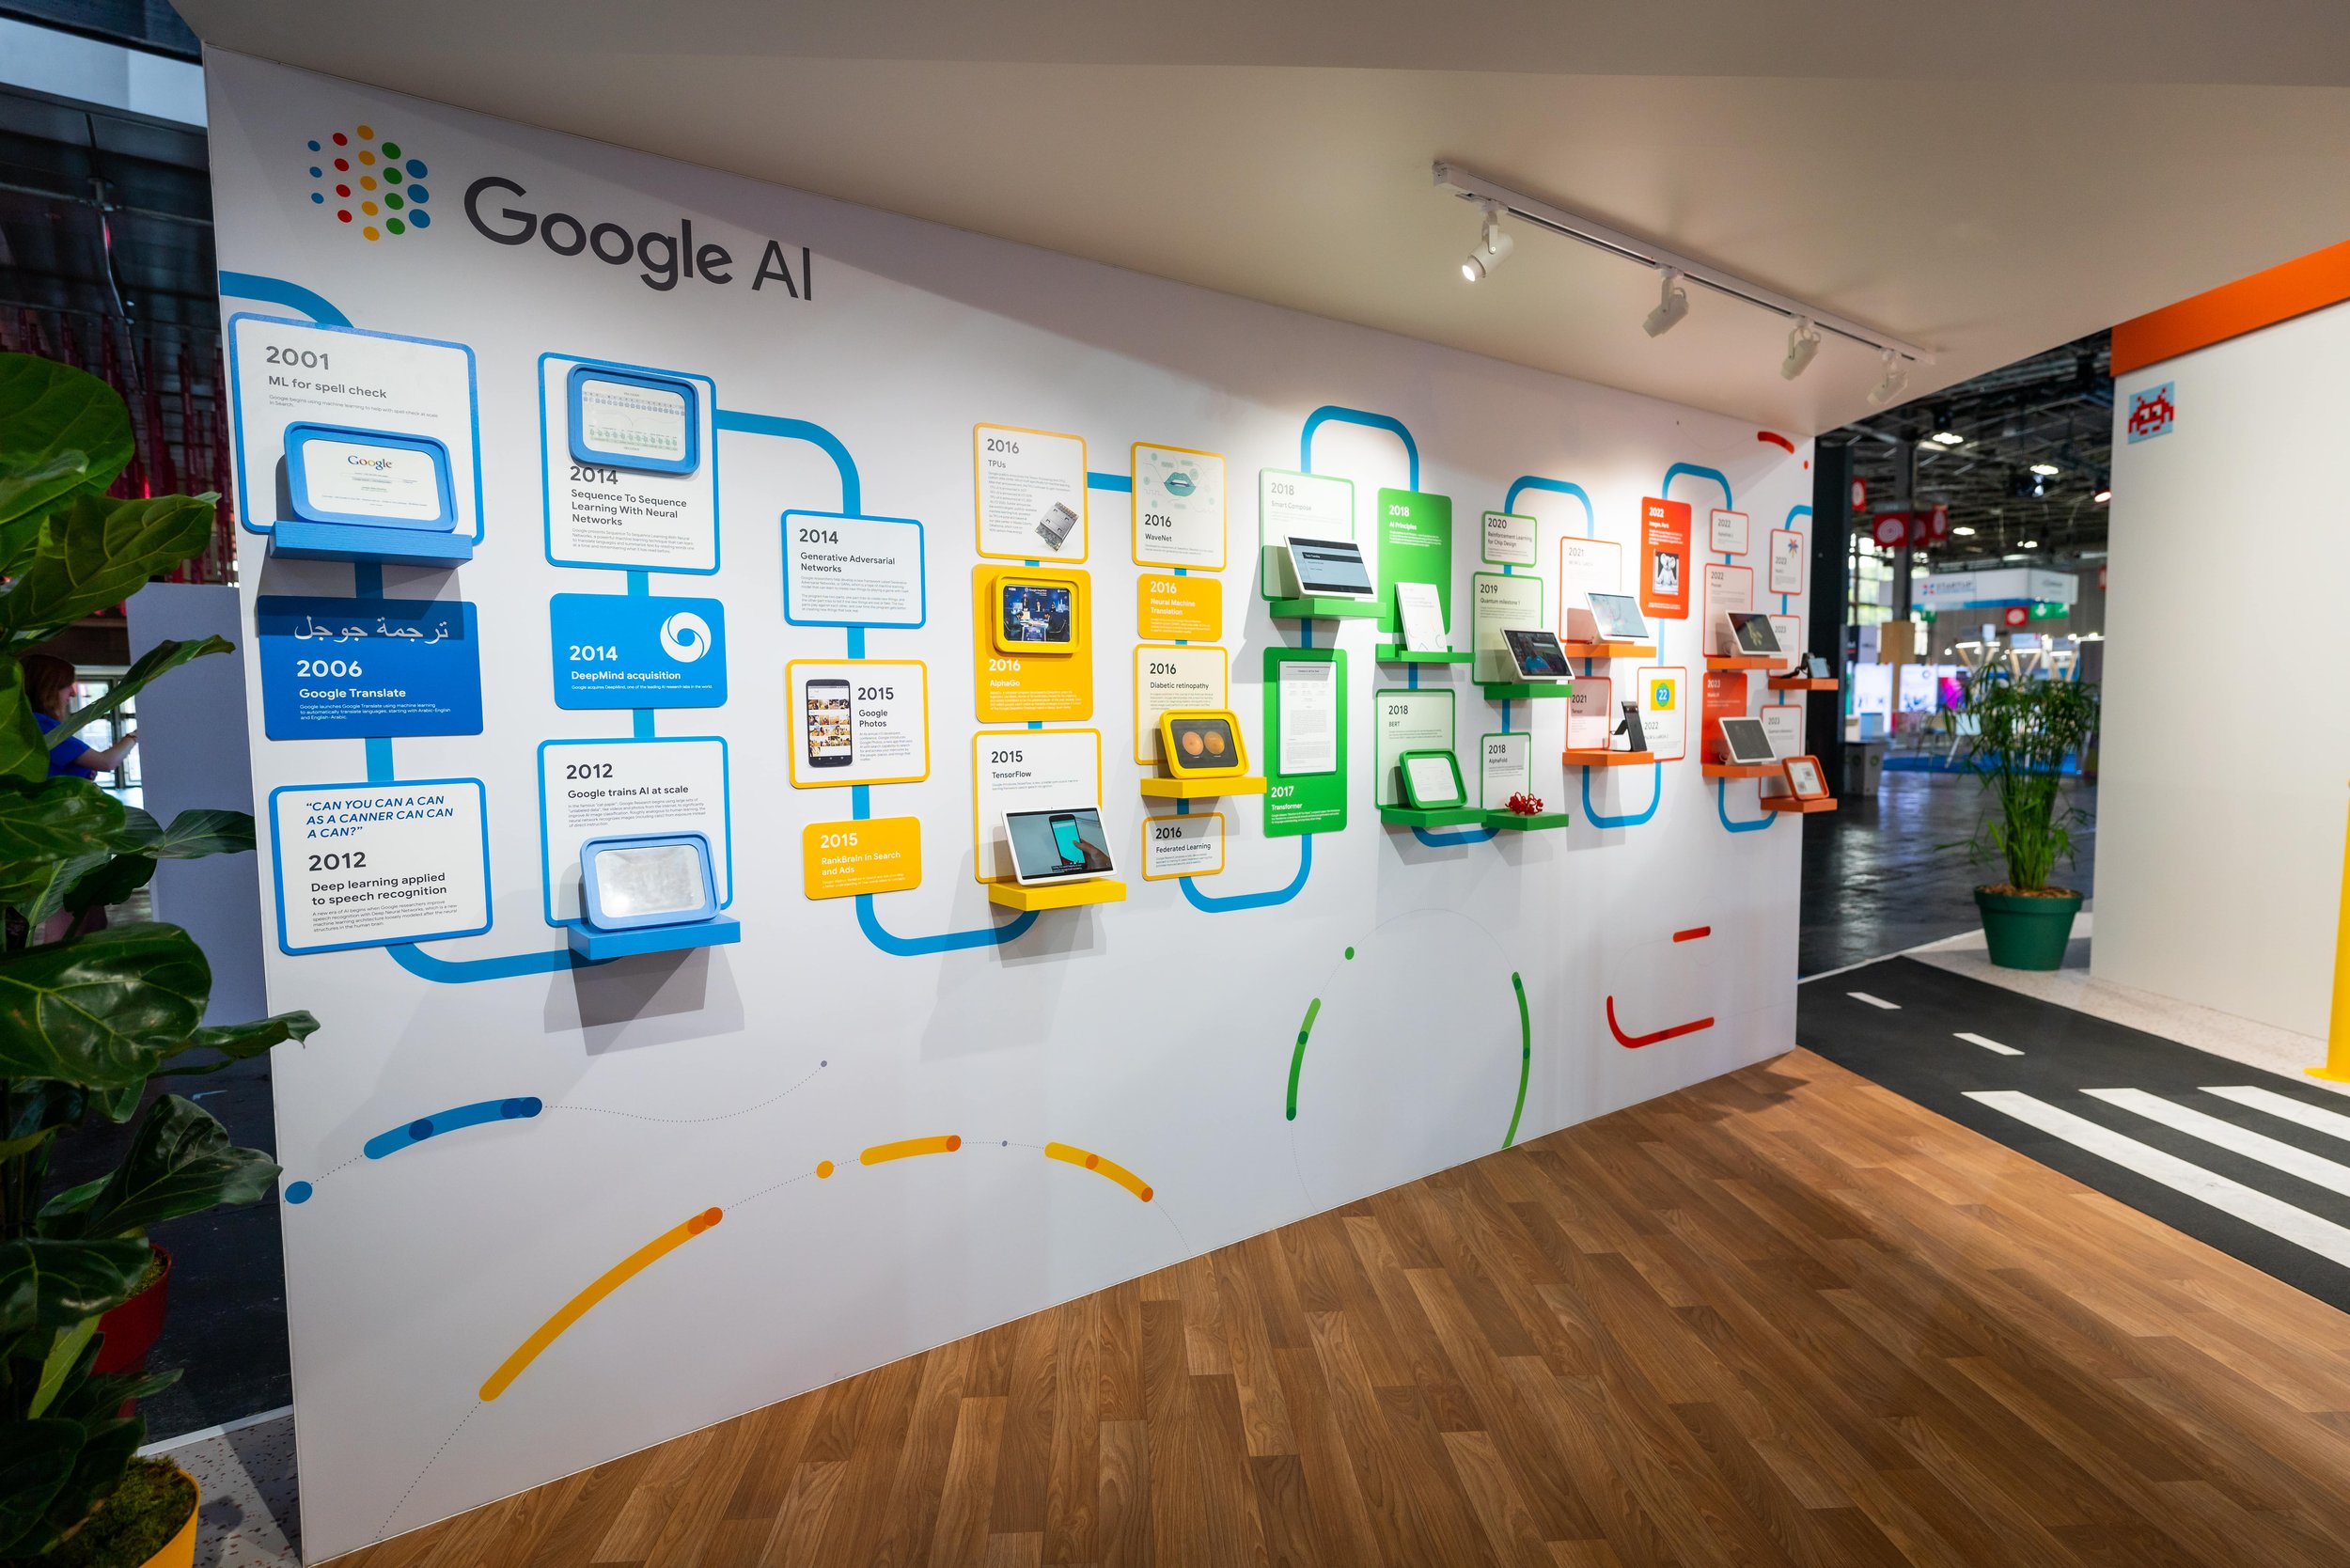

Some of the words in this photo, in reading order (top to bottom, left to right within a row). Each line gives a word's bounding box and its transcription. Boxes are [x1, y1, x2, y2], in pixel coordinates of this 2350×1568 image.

[463, 176, 733, 291] Google
[751, 240, 811, 301] AI
[265, 345, 329, 369] 2001
[268, 376, 289, 387] ML
[291, 378, 311, 389] for
[315, 381, 345, 394] spell
[349, 386, 387, 398] check
[987, 438, 1019, 454] 2016
[347, 455, 392, 471] Google
[988, 459, 1006, 469] TPUs
[570, 465, 619, 484] 2014
[1271, 482, 1294, 495] 2018
[571, 489, 622, 502] Sequence
[624, 494, 636, 503] To
[638, 495, 687, 508] Sequence
[572, 501, 617, 515] Learning
[619, 506, 643, 516] With
[646, 508, 678, 518] Neural
[1271, 500, 1287, 509] Smart
[1288, 502, 1311, 511] Compose
[1388, 504, 1410, 517] 2018
[572, 513, 622, 525] Networks
[1144, 513, 1172, 528] 2016
[1487, 518, 1507, 529] 2020
[1395, 522, 1418, 531] Principles
[799, 528, 838, 544] 2014
[1145, 533, 1172, 542] WaveNet
[1515, 534, 1533, 542] Learning
[800, 552, 848, 562] Generative
[849, 555, 896, 565] Adversarial
[801, 563, 842, 572] Networks
[1150, 580, 1177, 594] 2016
[1480, 584, 1498, 594] 2019
[1171, 599, 1196, 607] Machine
[1480, 597, 1498, 605] Quantum
[1150, 607, 1183, 616] Translation
[294, 615, 368, 643] جوجل
[376, 616, 449, 644] ترجمة
[569, 645, 619, 662] 2014
[296, 660, 363, 678] 2006
[988, 658, 1021, 672] 2016
[1150, 663, 1177, 674] 2016
[571, 670, 625, 682] DeepMind
[626, 670, 681, 682] acquisition
[989, 679, 1020, 688] AlphaGo
[299, 689, 347, 700] Google
[349, 688, 406, 698] Translate
[857, 687, 894, 700] 2015
[1572, 694, 1588, 703] 2021
[1658, 689, 1668, 700] 22
[858, 709, 888, 719] Google
[1388, 705, 1409, 715] 2018
[859, 719, 887, 728] Photos
[1488, 745, 1506, 754] 2018
[991, 750, 1023, 763] 2015
[566, 763, 613, 780] 2012
[992, 771, 1032, 779] TensorFlow
[568, 789, 605, 800] Google
[608, 787, 637, 796] trains
[639, 787, 650, 795] AI
[664, 785, 689, 794] scale
[1271, 786, 1294, 798] 2017
[306, 800, 341, 811] “CAN
[345, 799, 372, 809] YOU
[375, 797, 402, 808] CAN
[405, 797, 415, 807] A
[416, 795, 445, 806] CAN
[1271, 803, 1303, 811] Transformer
[306, 815, 324, 825] AS
[326, 814, 337, 823] A
[338, 811, 394, 823] CANNER
[396, 809, 424, 820] CAN
[426, 808, 454, 818] CAN
[306, 829, 317, 839] A
[320, 825, 363, 838] CAN?”
[1155, 826, 1182, 839] 2016
[820, 832, 858, 849] 2015
[1155, 845, 1185, 854] Federated
[1186, 842, 1211, 851] Learning
[308, 851, 367, 872] 2012
[821, 855, 863, 865] RankBrain
[873, 851, 901, 860] Search
[822, 867, 838, 876] and
[838, 866, 854, 874] Ads
[310, 881, 345, 892] Deep
[348, 876, 399, 889] learning
[401, 872, 446, 886] applied
[311, 896, 326, 906] to
[328, 892, 374, 905] speech
[377, 886, 447, 901] recognition
